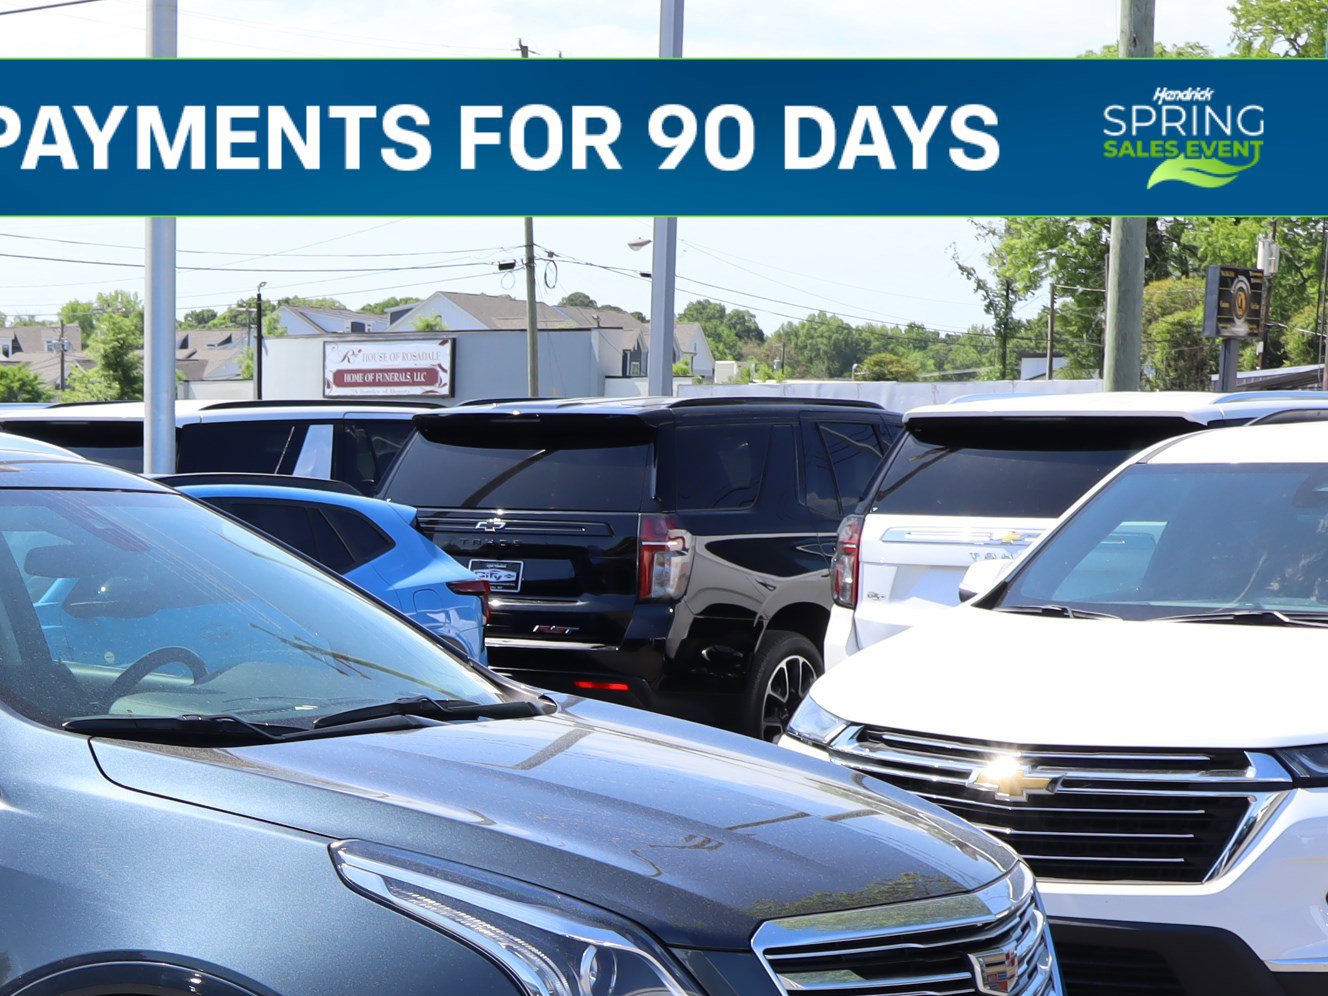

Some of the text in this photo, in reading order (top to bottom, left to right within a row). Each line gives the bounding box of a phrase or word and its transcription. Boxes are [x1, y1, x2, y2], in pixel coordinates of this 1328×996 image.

[362, 351, 441, 362] HOUSE OF ROSADALE
[343, 371, 427, 383] HOME OF FUNERALS, LLC
